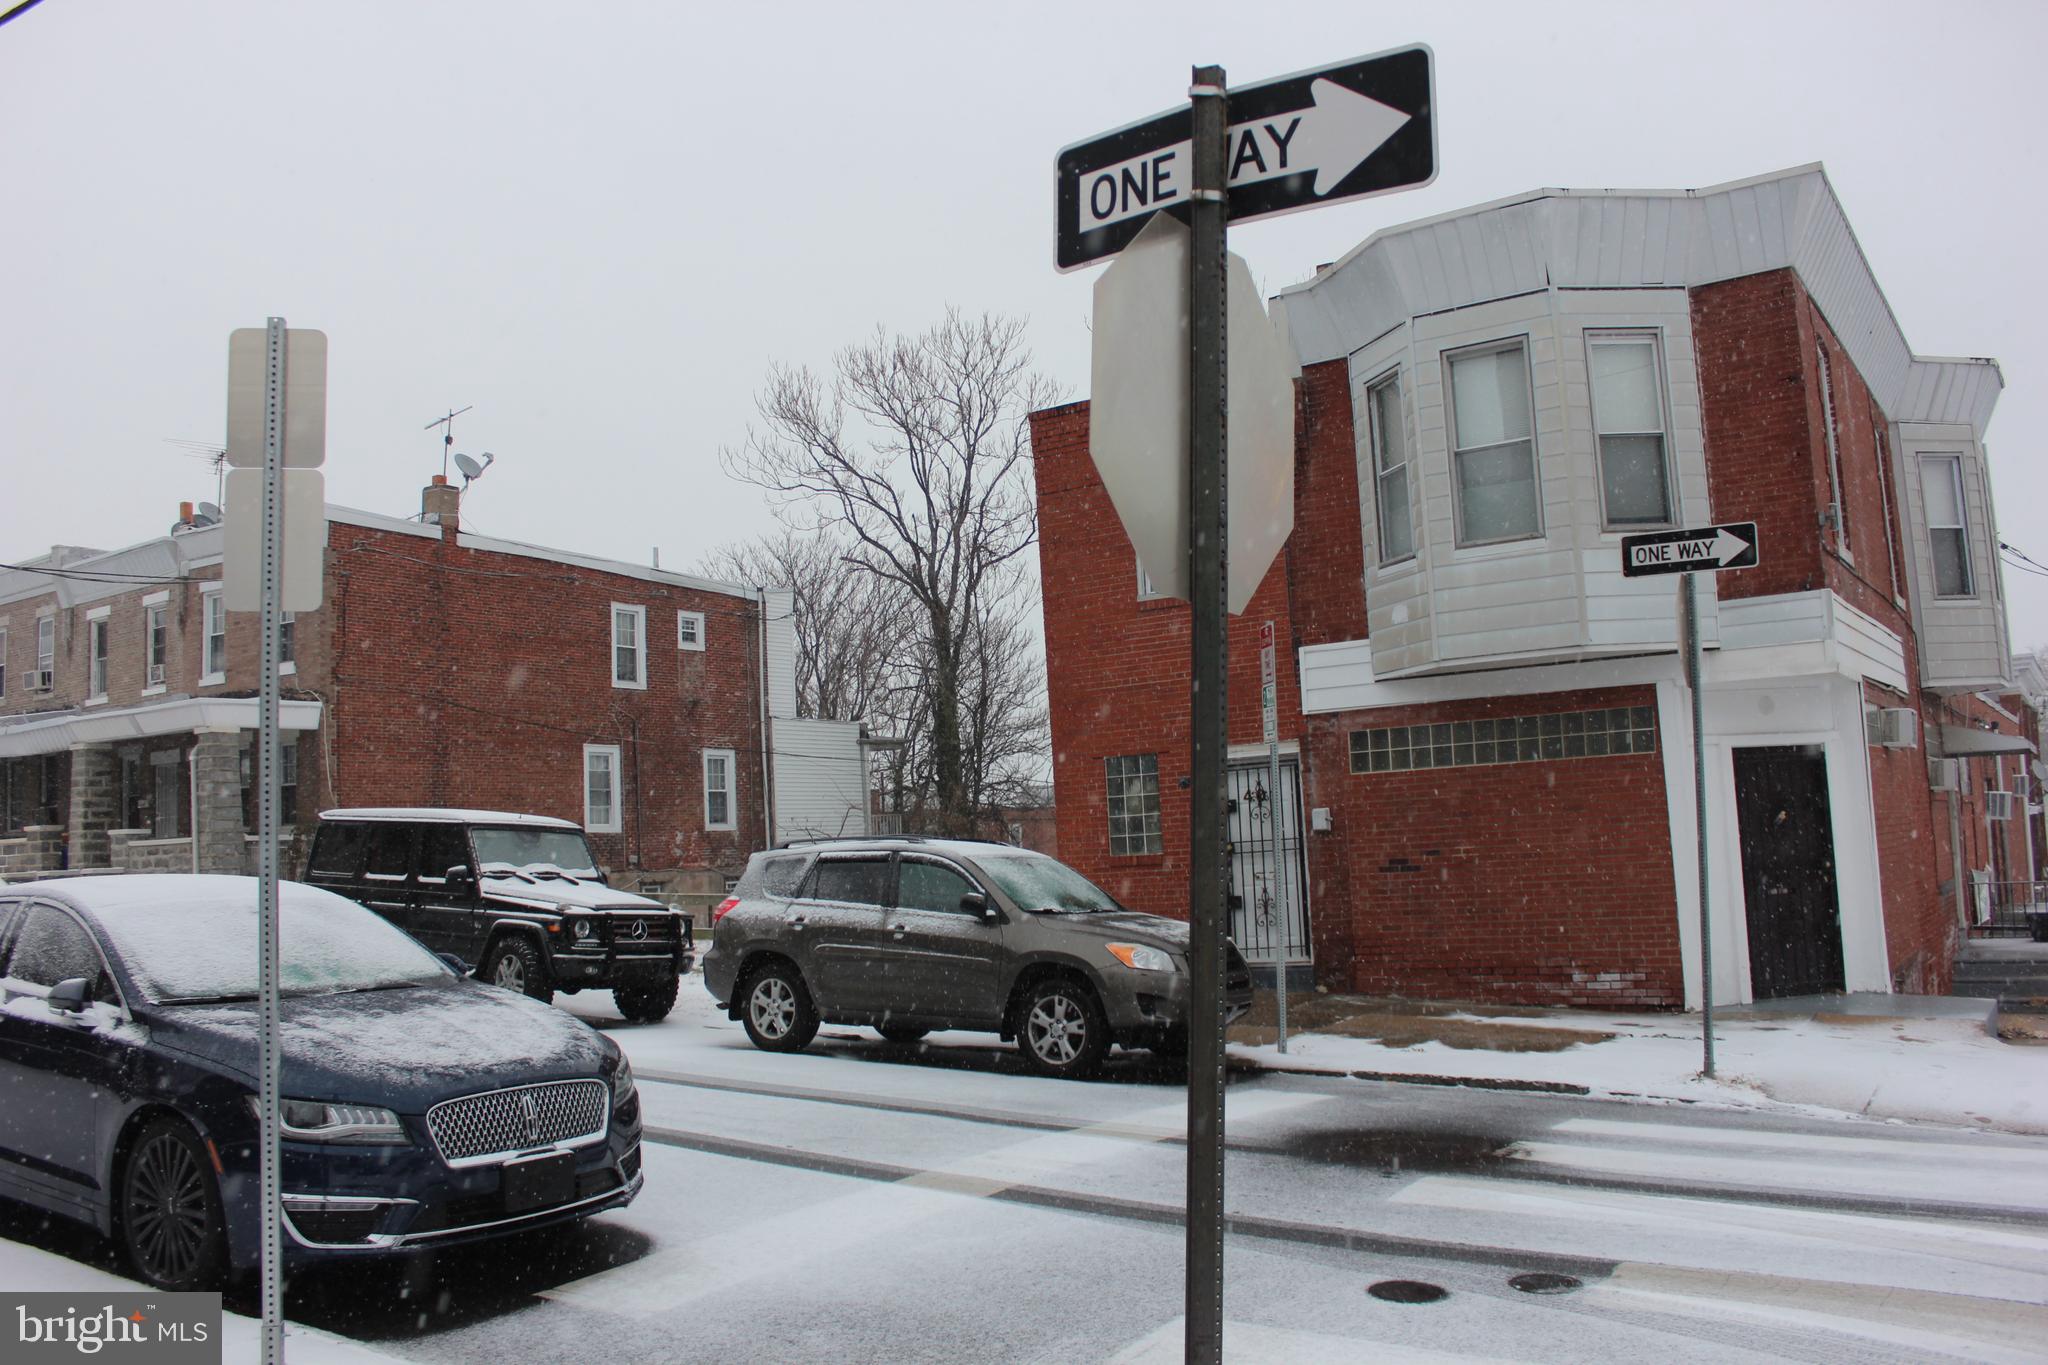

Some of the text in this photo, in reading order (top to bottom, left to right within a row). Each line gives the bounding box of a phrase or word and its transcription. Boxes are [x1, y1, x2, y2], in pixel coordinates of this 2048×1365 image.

[1090, 116, 1302, 220] ONE AY
[1635, 540, 1714, 564] ONE WAY
